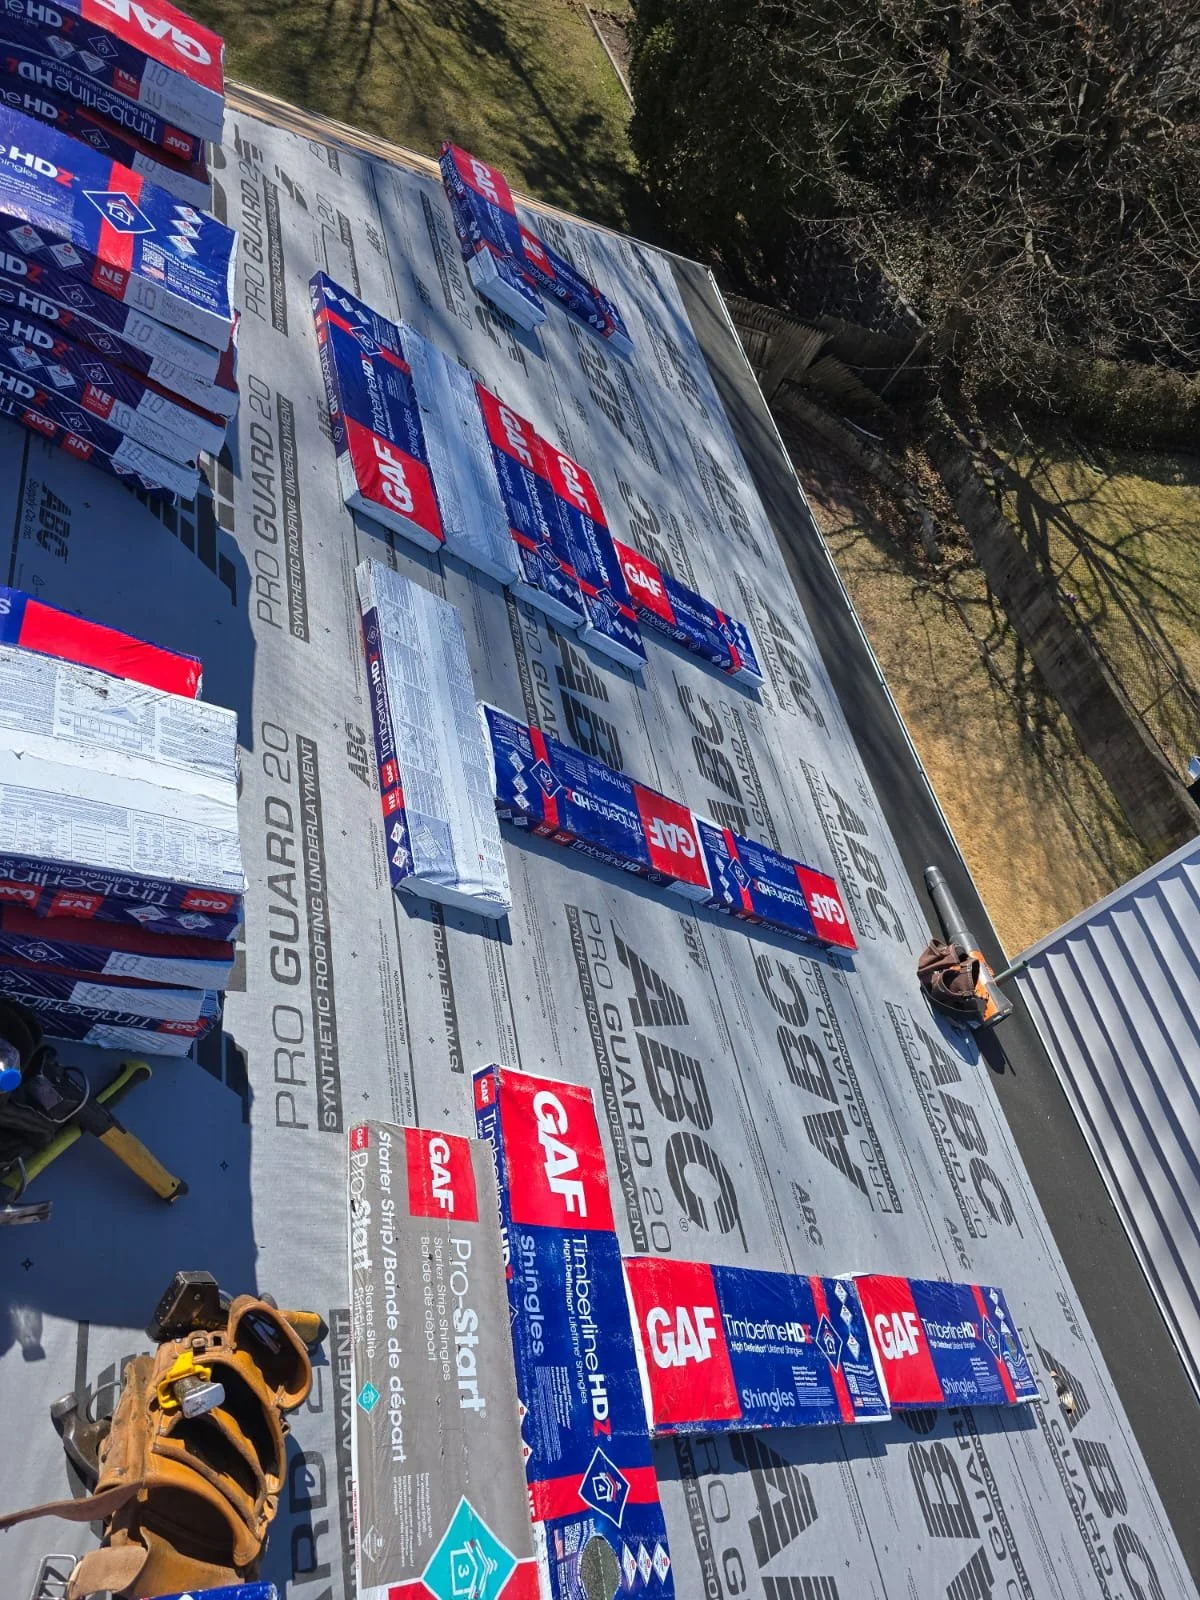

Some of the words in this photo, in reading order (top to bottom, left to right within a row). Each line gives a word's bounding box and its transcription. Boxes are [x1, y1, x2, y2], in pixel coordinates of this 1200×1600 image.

[166, 136, 190, 153] GAF
[469, 159, 500, 204] GAF
[241, 179, 263, 264] GUARD
[100, 266, 124, 284] NE
[137, 281, 157, 305] 10
[244, 265, 266, 321] PRO
[126, 318, 154, 343] 10
[28, 412, 56, 431] GAF
[89, 383, 113, 404] NE
[248, 374, 272, 421] 20
[69, 437, 90, 453] NE
[280, 399, 297, 501] UNDERLAYMENT
[403, 408, 421, 457] Shingles
[498, 405, 534, 469] GAF
[251, 422, 278, 544] GUARD
[372, 437, 414, 513] GAF
[558, 454, 591, 517] GAF
[37, 481, 72, 564] ABC
[283, 498, 301, 558] ROOFING
[254, 549, 282, 630] PRO
[287, 556, 305, 639] SYNTHETIC
[624, 562, 663, 598] GAF
[719, 700, 735, 731] 20
[262, 721, 291, 784] 20
[345, 716, 371, 790] ABC
[588, 764, 631, 794] Shingles
[388, 793, 396, 809] NE
[731, 739, 764, 827] GUARD
[301, 739, 322, 892] UNDERLAYMENT
[649, 818, 696, 859] GAF
[20, 861, 72, 876] Lifetime
[79, 870, 139, 886] Definition
[141, 880, 172, 893] High
[264, 795, 302, 985] GUARD
[763, 854, 795, 874] Shingles
[821, 771, 913, 955] ABC
[826, 814, 861, 900] GUARD
[858, 907, 876, 941] 20
[188, 897, 228, 911] GAF
[810, 893, 845, 924] GAF
[312, 897, 328, 991] ROOFING
[679, 915, 704, 970] ABC
[798, 956, 819, 997] 20
[437, 959, 459, 1069] SYNTHETIC
[272, 1004, 308, 1130] PRO
[318, 996, 336, 1127] SYNTHETIC
[567, 906, 596, 998] SYNTHETIC
[587, 998, 608, 1077] ROOFING
[601, 1078, 647, 1251] UNDERLAYMENT
[583, 909, 614, 990] PRO
[603, 1002, 653, 1168] GUARD
[642, 1187, 672, 1253] 20
[610, 919, 749, 1253] ABC
[746, 938, 875, 1213] ABC
[815, 1006, 862, 1128] GUARD
[480, 1079, 489, 1104] GAF
[894, 1004, 921, 1062] PRO
[919, 1070, 966, 1183] GUARD
[964, 1196, 987, 1239] 20
[908, 1008, 1024, 1239] ABC
[378, 1130, 392, 1195] Starter
[428, 1137, 454, 1213] GAF
[533, 1090, 588, 1218] GAF
[859, 1139, 893, 1213] PRO
[350, 1151, 372, 1273] Pro-Start
[794, 1182, 826, 1250] ABC
[381, 1199, 400, 1330] Strip/Bande
[421, 1236, 431, 1282] Bande
[434, 1236, 445, 1285] Starter
[563, 1239, 571, 1259] High
[944, 1216, 975, 1271] ABC
[365, 1284, 375, 1328] Starter
[423, 1286, 432, 1306] de
[436, 1286, 446, 1315] Strip
[520, 1234, 544, 1356] Shingles
[566, 1260, 575, 1313] Definition
[366, 1330, 375, 1359] Strip
[424, 1310, 437, 1361] départ
[439, 1319, 451, 1381] Shingles
[449, 1237, 486, 1412] Pro-Start
[569, 1316, 580, 1358] Lifetime
[646, 1306, 718, 1369] GAF
[874, 1311, 920, 1360] GAF
[388, 1337, 402, 1369] de
[576, 1360, 587, 1404] Shingles
[741, 1388, 796, 1412] Shingles
[941, 1377, 978, 1398] Shingles
[388, 1375, 407, 1463] départ
[1050, 1418, 1114, 1577] GUARD
[458, 1562, 470, 1579] 3
